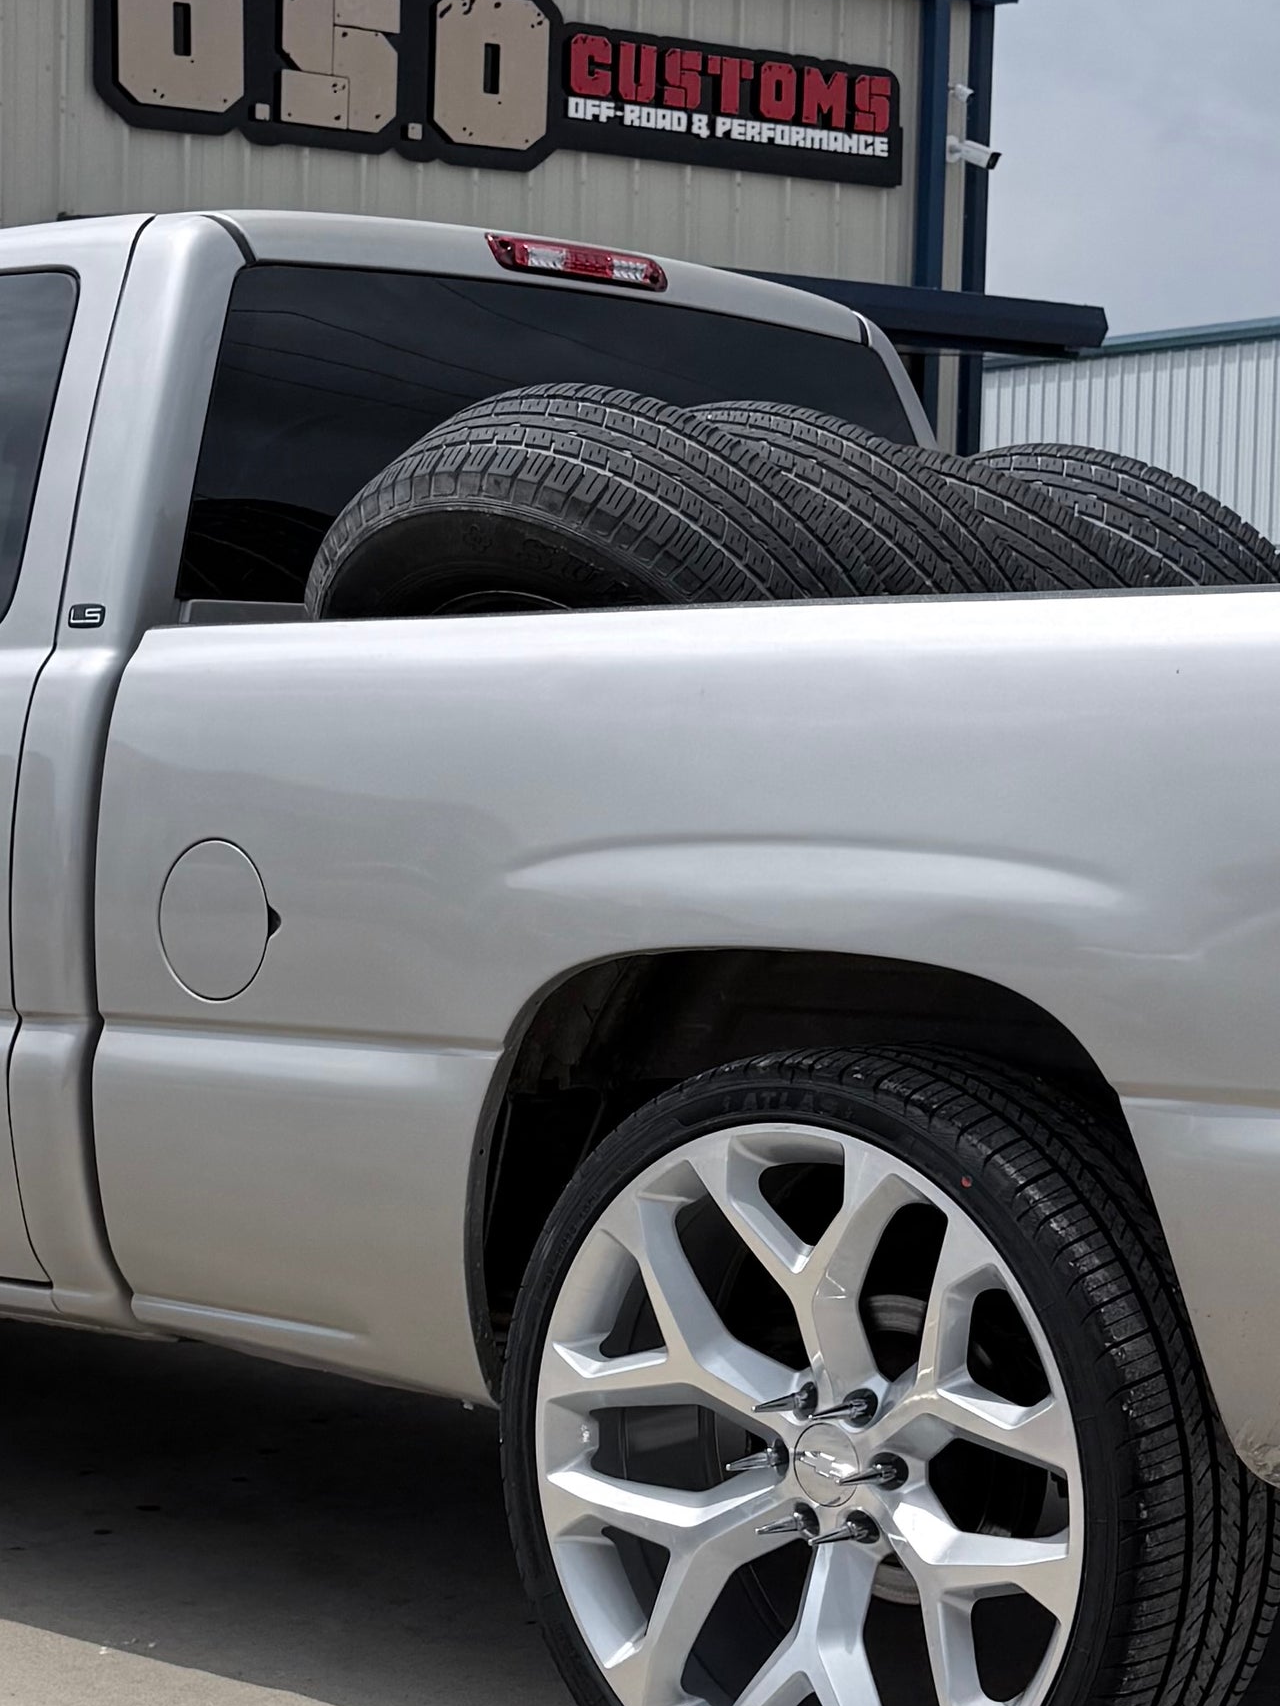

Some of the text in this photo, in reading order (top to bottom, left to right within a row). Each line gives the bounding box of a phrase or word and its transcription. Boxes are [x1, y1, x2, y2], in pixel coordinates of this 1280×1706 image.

[569, 33, 891, 133] CUSTOMS
[567, 96, 889, 158] OFF-ROAD & PERFORMANCE
[70, 607, 102, 624] LS
